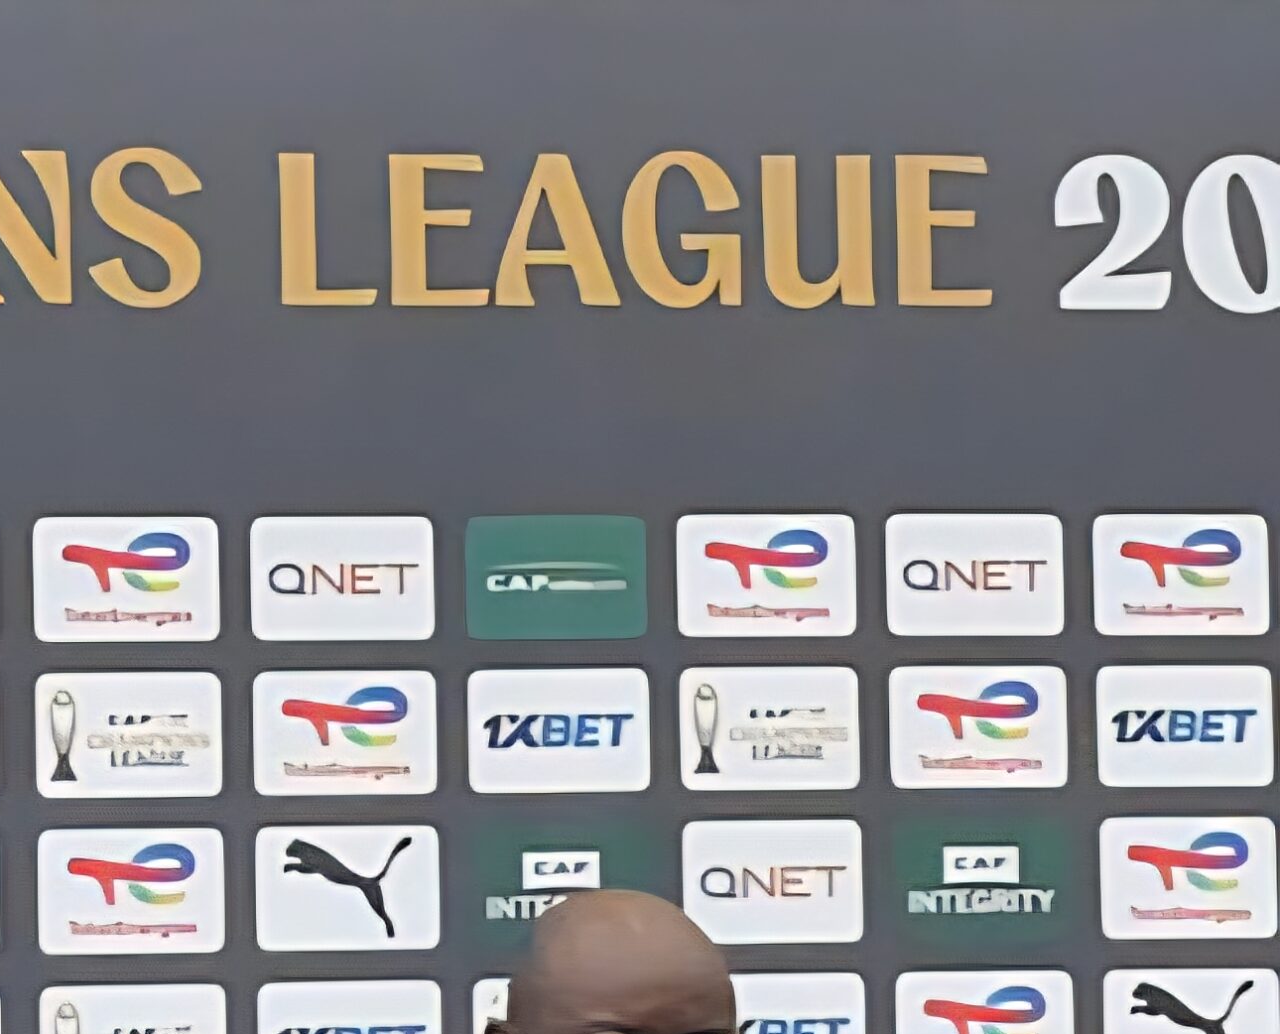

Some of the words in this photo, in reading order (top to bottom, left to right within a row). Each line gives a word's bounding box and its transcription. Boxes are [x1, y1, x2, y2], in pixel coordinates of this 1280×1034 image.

[279, 150, 993, 309] LEAGUE
[1054, 154, 1280, 313] 20
[269, 564, 418, 595] QNET
[903, 560, 1047, 591] QNET
[483, 714, 634, 748] 1XBET
[1112, 709, 1257, 743] 1XBET
[701, 866, 846, 898] QNET
